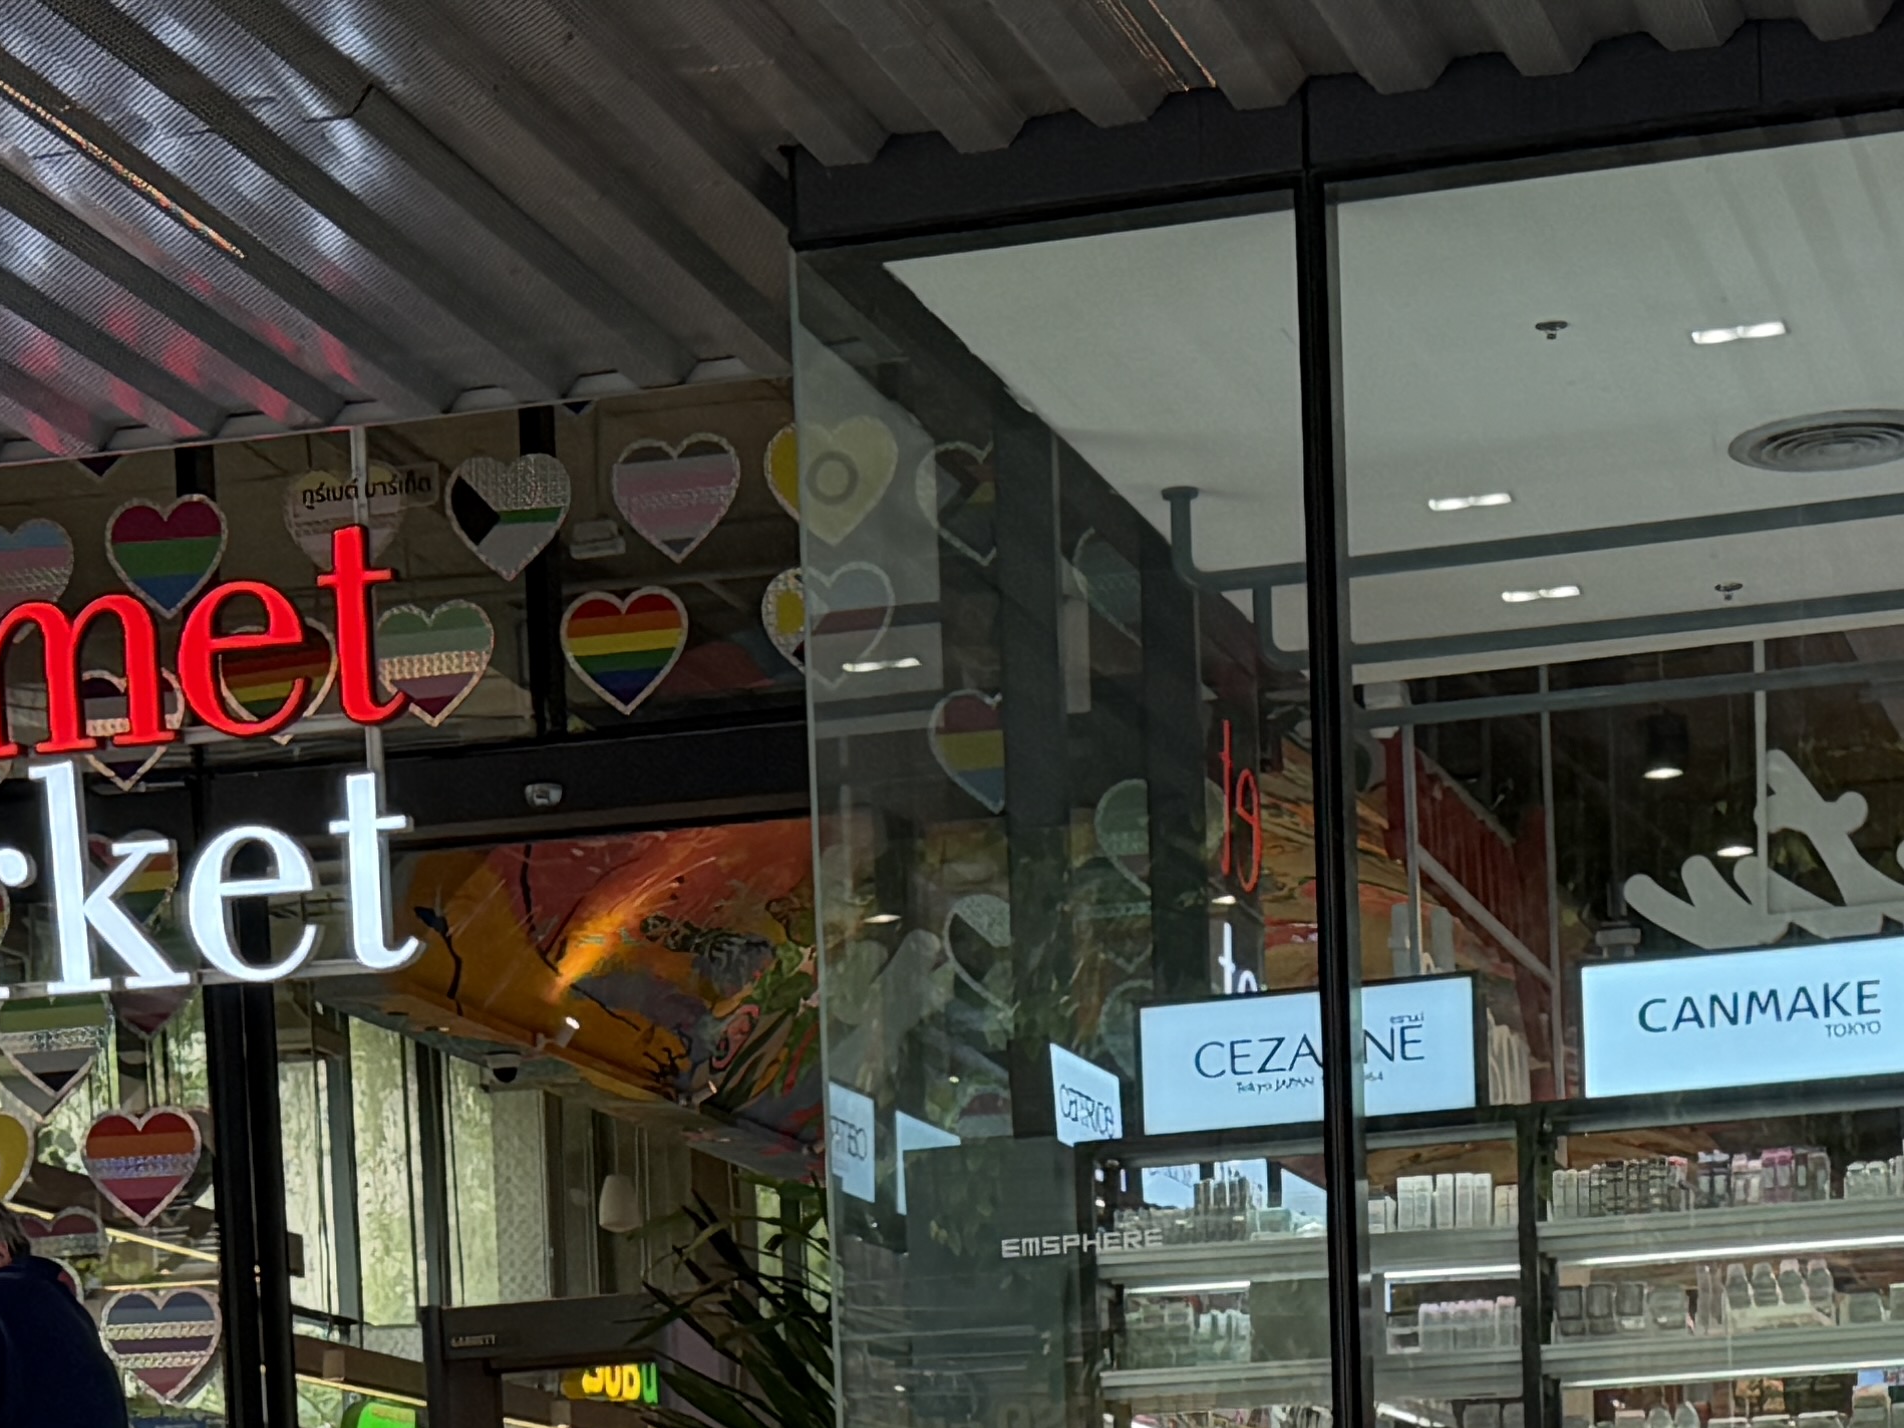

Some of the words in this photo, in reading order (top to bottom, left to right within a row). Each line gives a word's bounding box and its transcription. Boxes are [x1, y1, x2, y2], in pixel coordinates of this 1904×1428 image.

[1638, 979, 1882, 1033] CANMAKE
[1825, 1020, 1882, 1038] TOKYO
[1195, 1024, 1426, 1078] CEZANE
[1001, 1228, 1164, 1259] EMSPHERE
